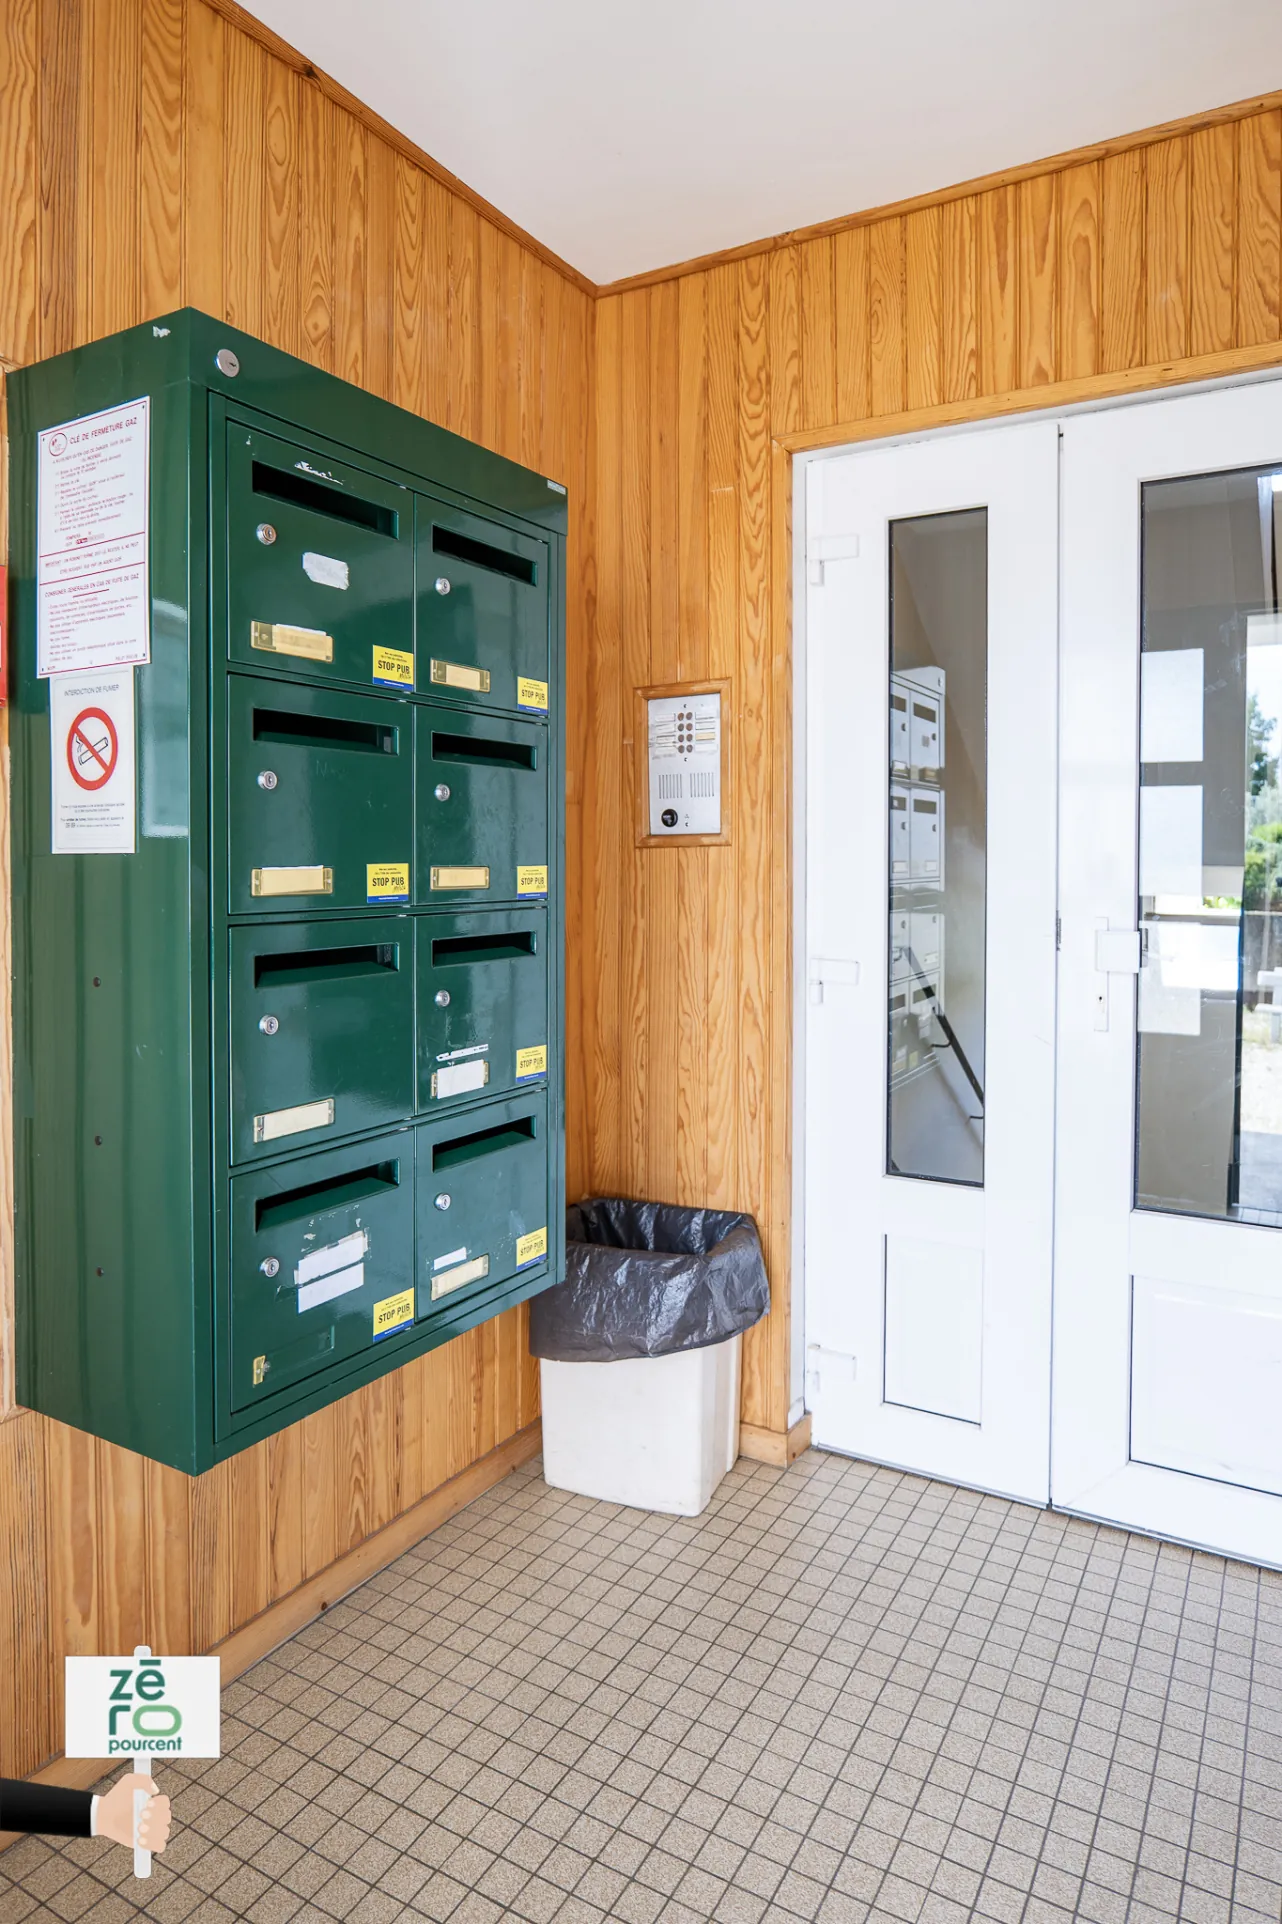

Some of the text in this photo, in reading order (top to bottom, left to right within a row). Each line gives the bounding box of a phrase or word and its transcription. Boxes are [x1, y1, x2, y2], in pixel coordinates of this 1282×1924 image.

[81, 432, 89, 441] DE
[91, 421, 123, 438] FERMETURE
[125, 416, 137, 427] GAZ
[378, 659, 410, 675] STOP PUB
[64, 687, 94, 697] INTERDICTION
[102, 684, 119, 692] FUMER
[521, 688, 545, 701] STOP PUB
[372, 876, 405, 887] STOP PUB
[521, 876, 545, 886] STOP PUB
[520, 1056, 543, 1069] STOP PUB
[520, 1244, 533, 1256] STOP
[534, 1239, 544, 1250] PUB
[378, 1309, 395, 1324] STOP
[397, 1303, 410, 1316] PUB
